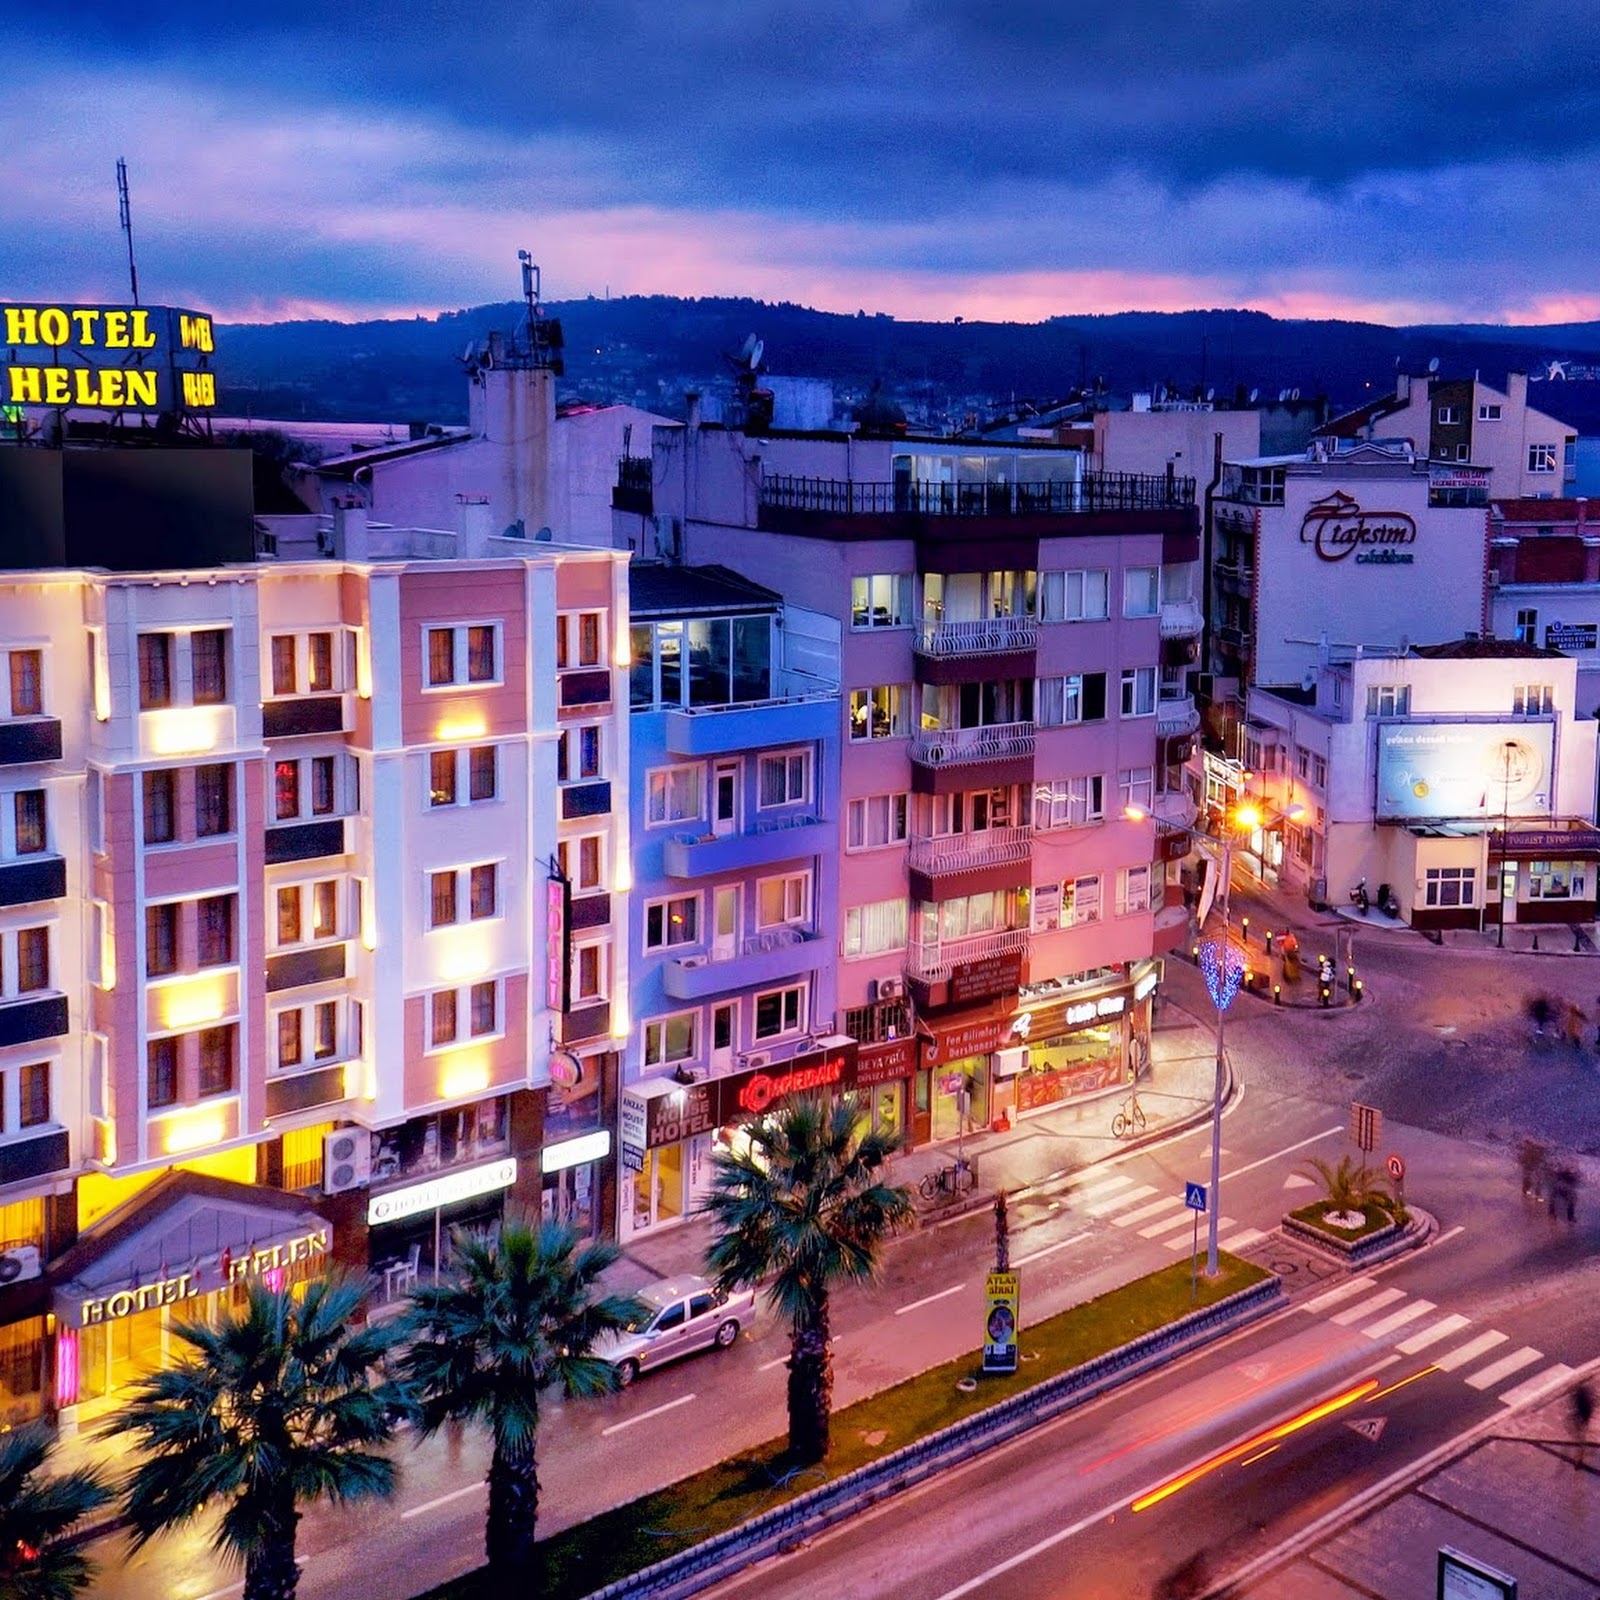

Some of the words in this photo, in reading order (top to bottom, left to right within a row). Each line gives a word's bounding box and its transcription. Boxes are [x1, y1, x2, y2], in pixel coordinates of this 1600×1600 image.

[4, 308, 156, 348] HOTEL
[8, 366, 157, 406] HELEN
[1509, 835, 1543, 844] TOURIST
[650, 1113, 714, 1146] HOTEL
[81, 1274, 200, 1326] HOTEL
[229, 1228, 328, 1284] HELEN
